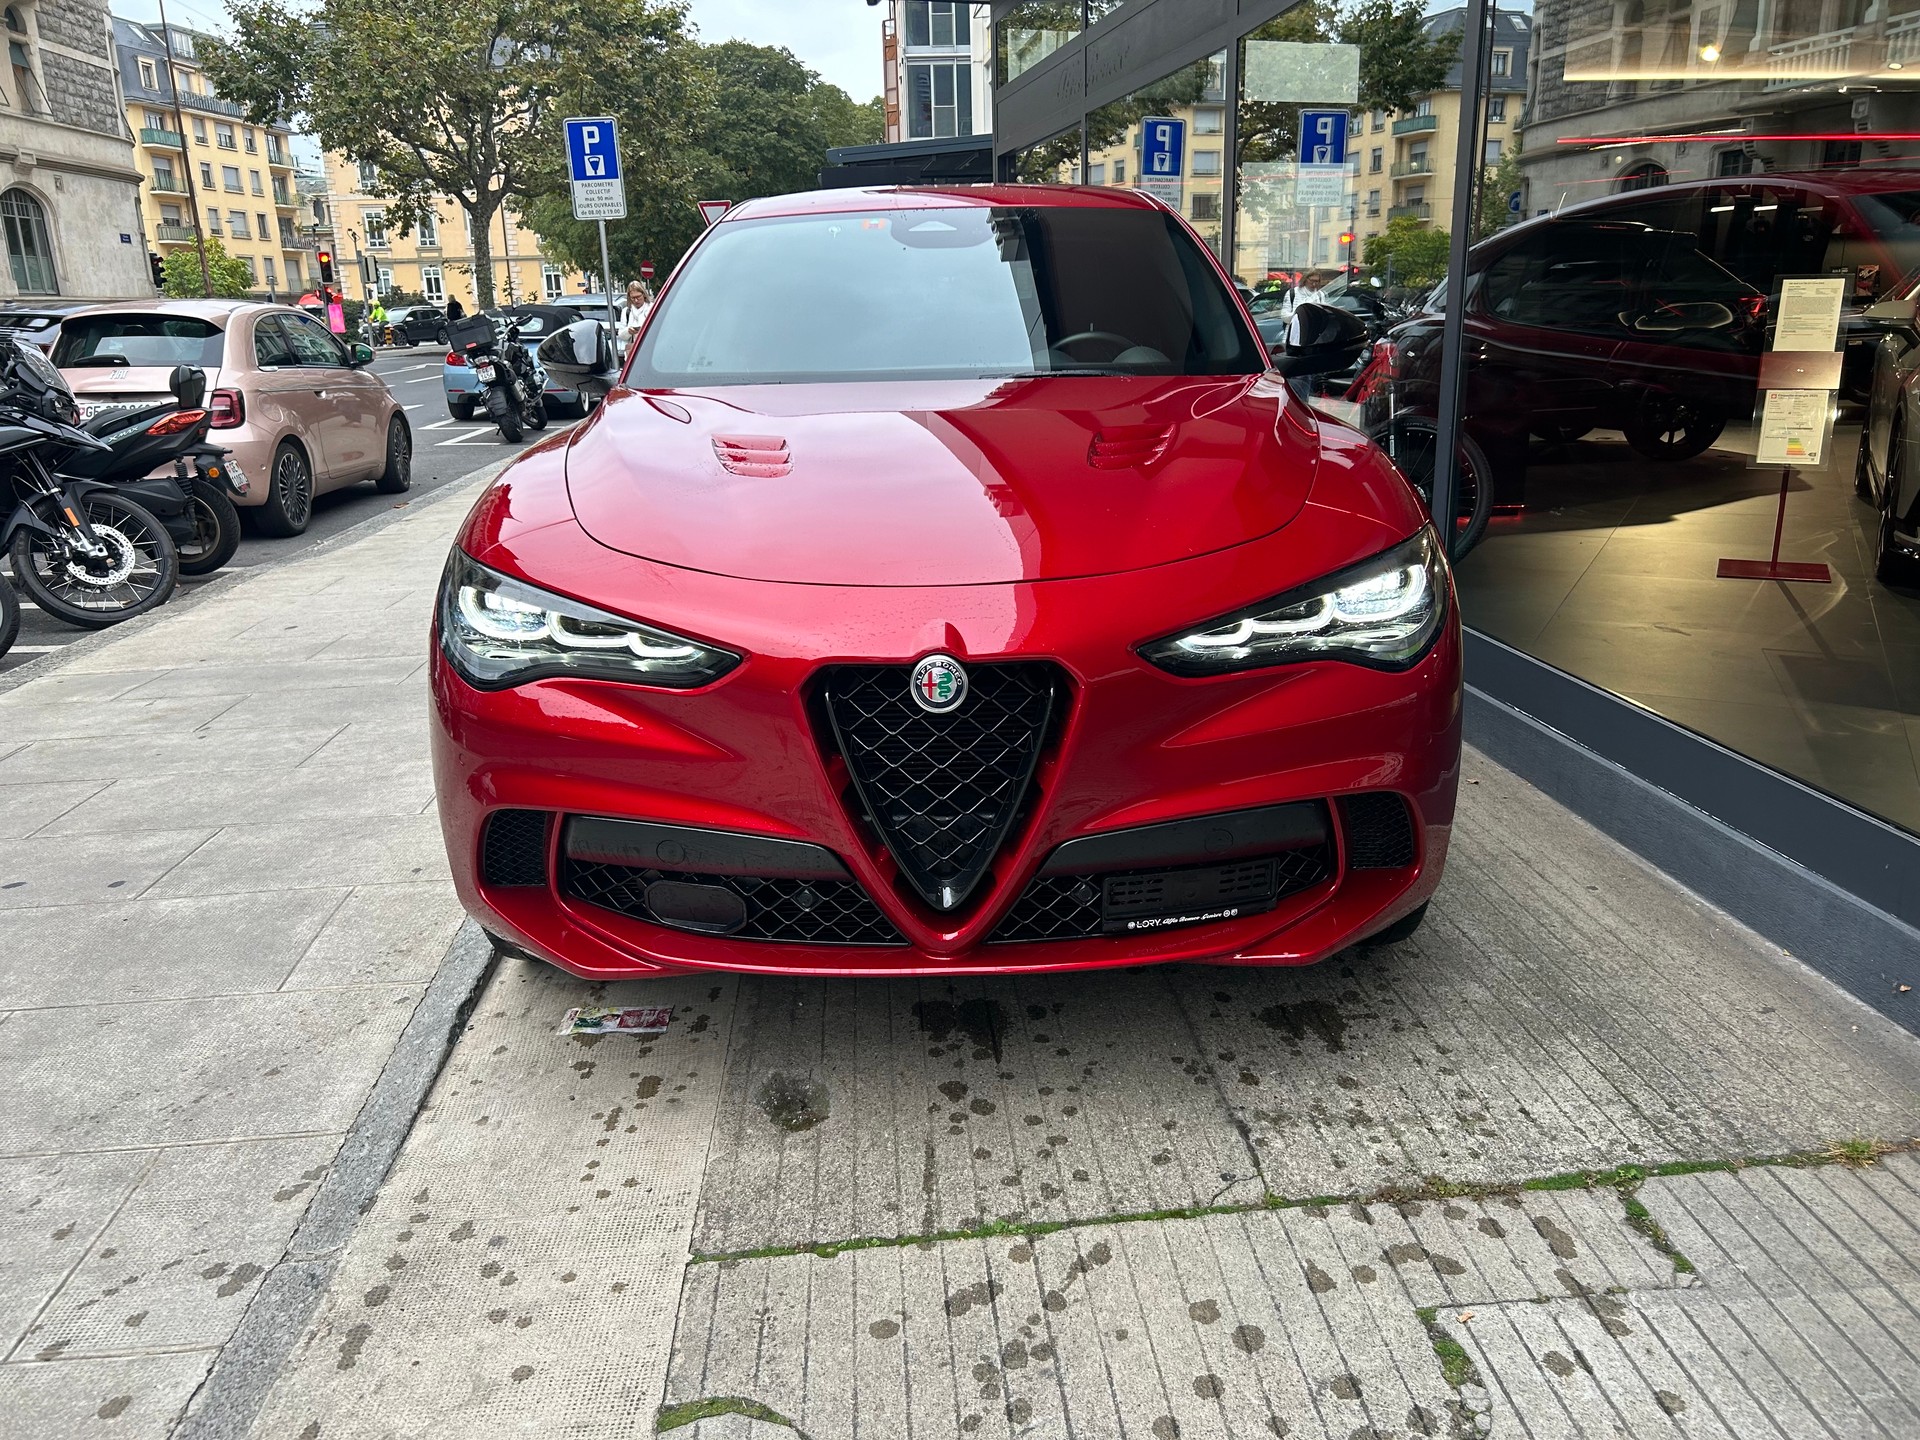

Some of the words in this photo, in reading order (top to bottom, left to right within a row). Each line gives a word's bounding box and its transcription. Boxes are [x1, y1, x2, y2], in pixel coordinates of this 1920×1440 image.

[582, 126, 600, 154] P
[109, 369, 129, 380] FIAT
[916, 665, 932, 686] ALFA
[935, 661, 962, 686] ROMEO
[1162, 917, 1178, 925] Alfa
